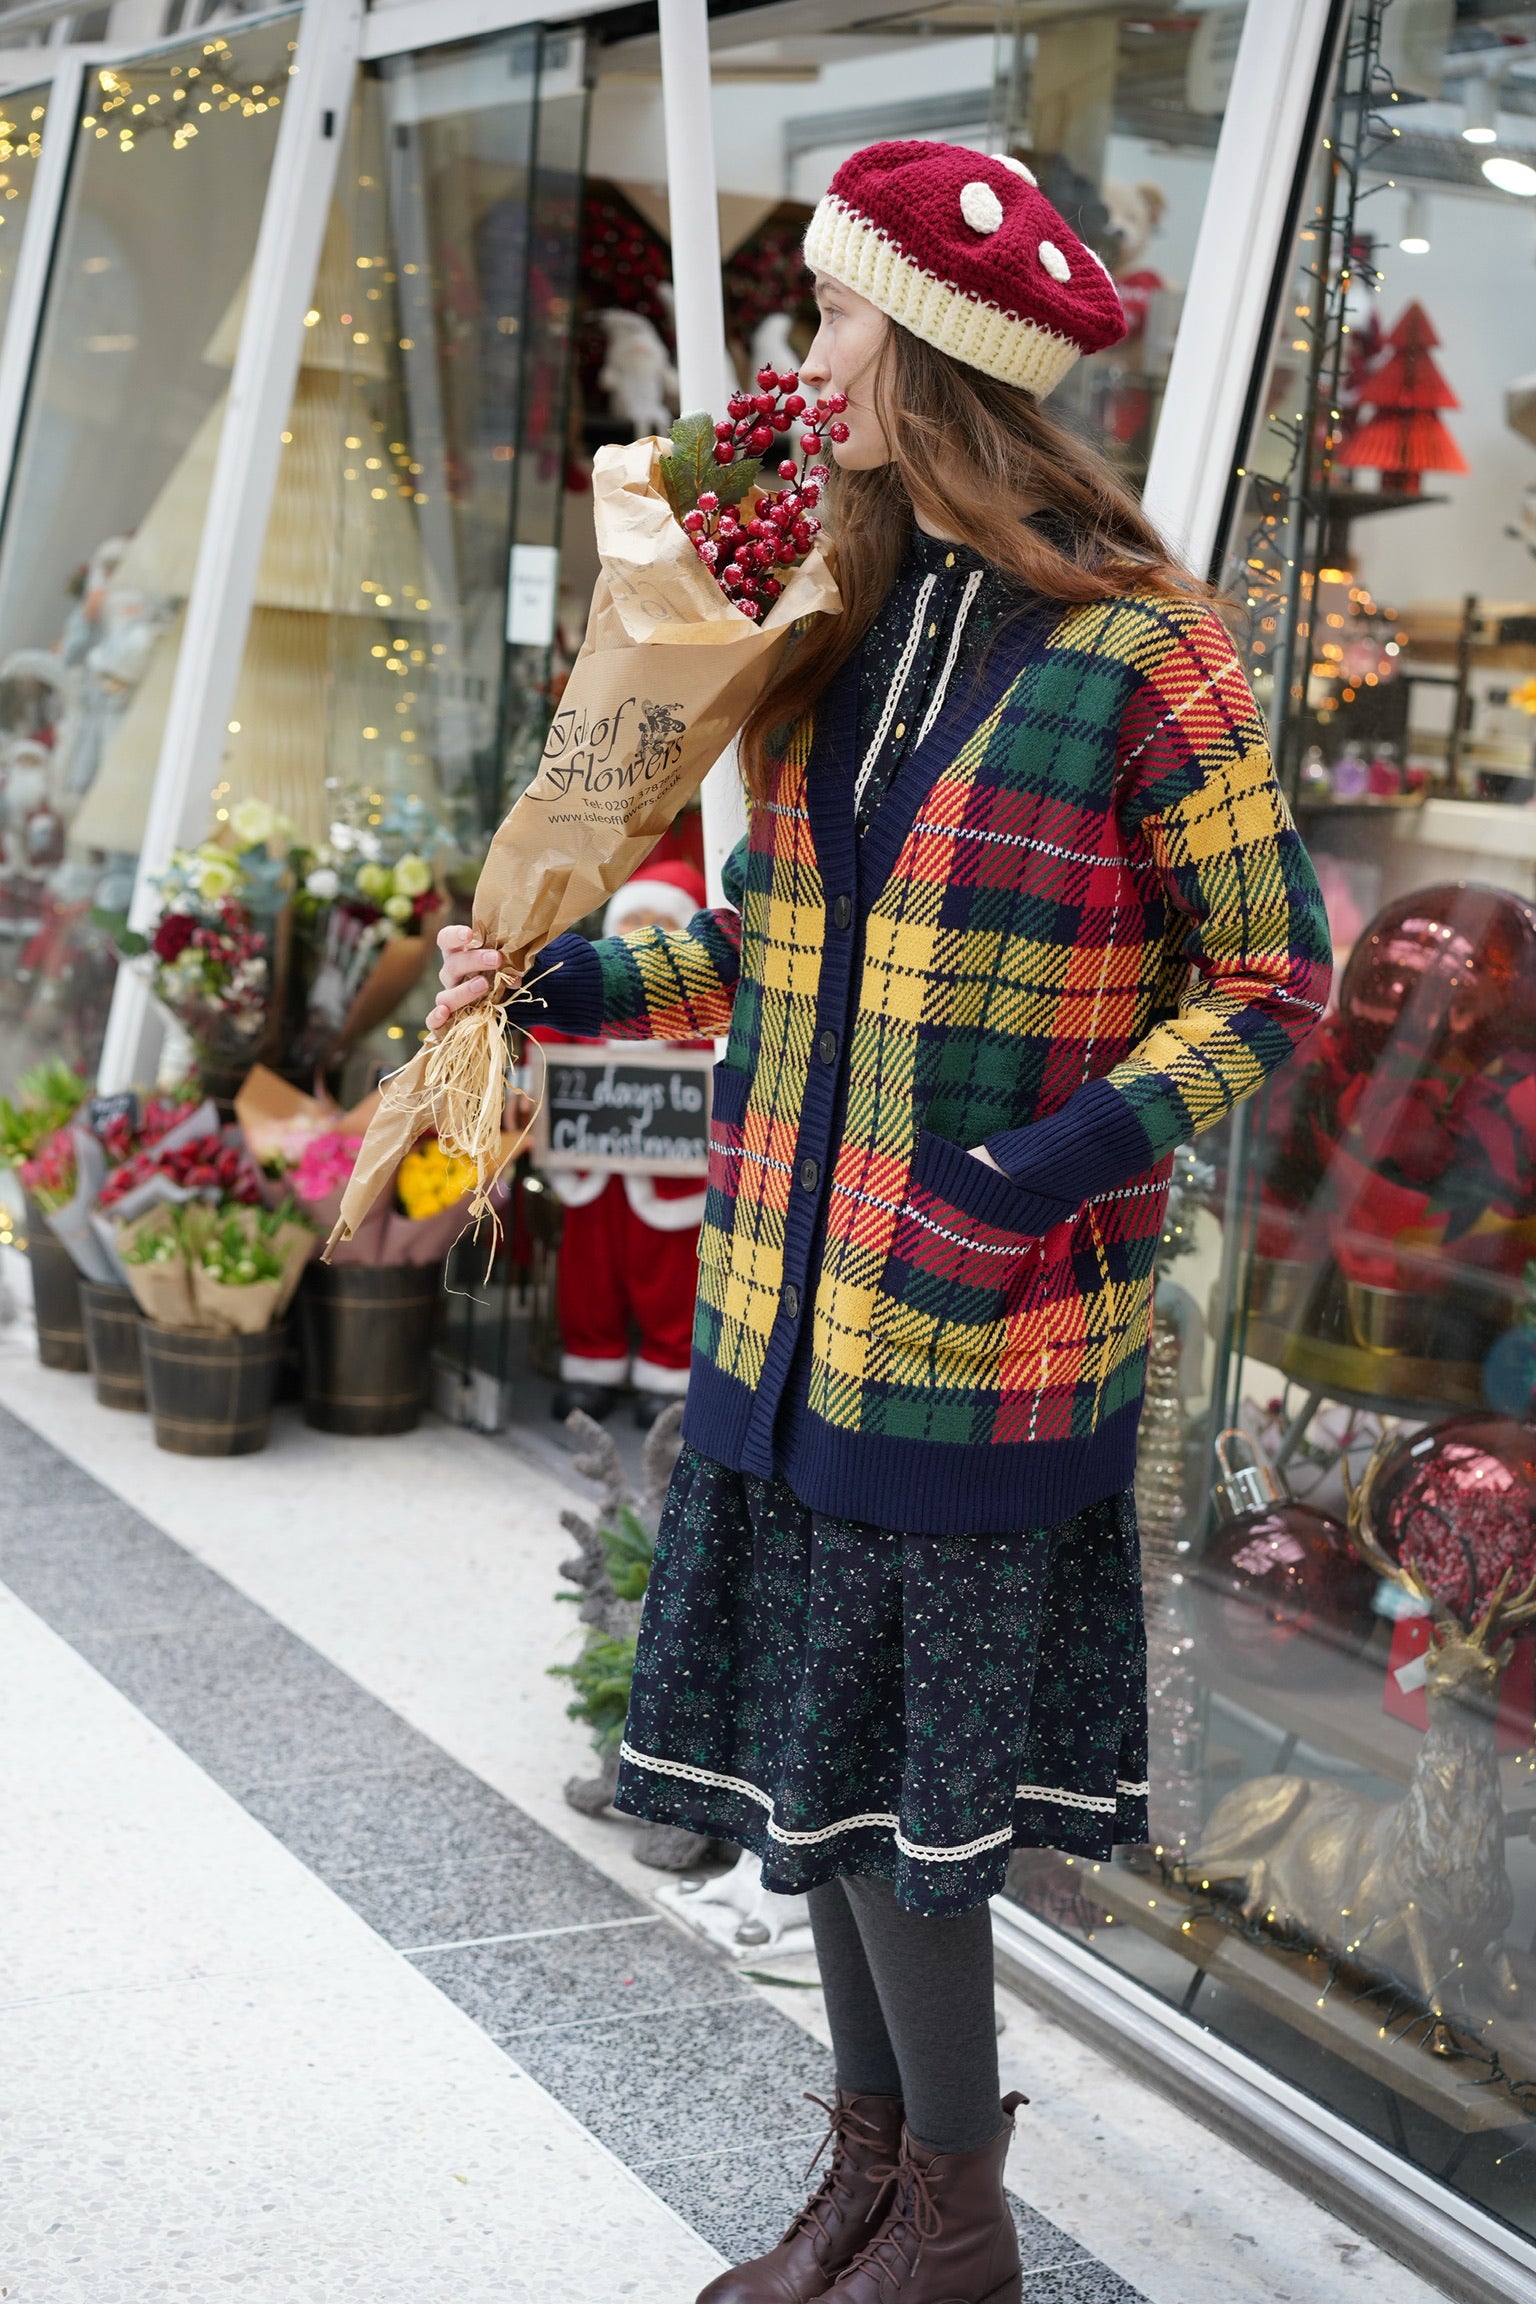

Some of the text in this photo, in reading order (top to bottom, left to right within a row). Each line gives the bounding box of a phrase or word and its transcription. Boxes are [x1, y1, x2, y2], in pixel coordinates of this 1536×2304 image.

[543, 696, 636, 763] Isl of
[548, 773, 682, 826] www.isleofflowers.co.uk
[581, 797, 604, 810] Tel:
[604, 796, 635, 812] 0207
[554, 1064, 703, 1129] 22 days to
[553, 1113, 706, 1157] Christmas
